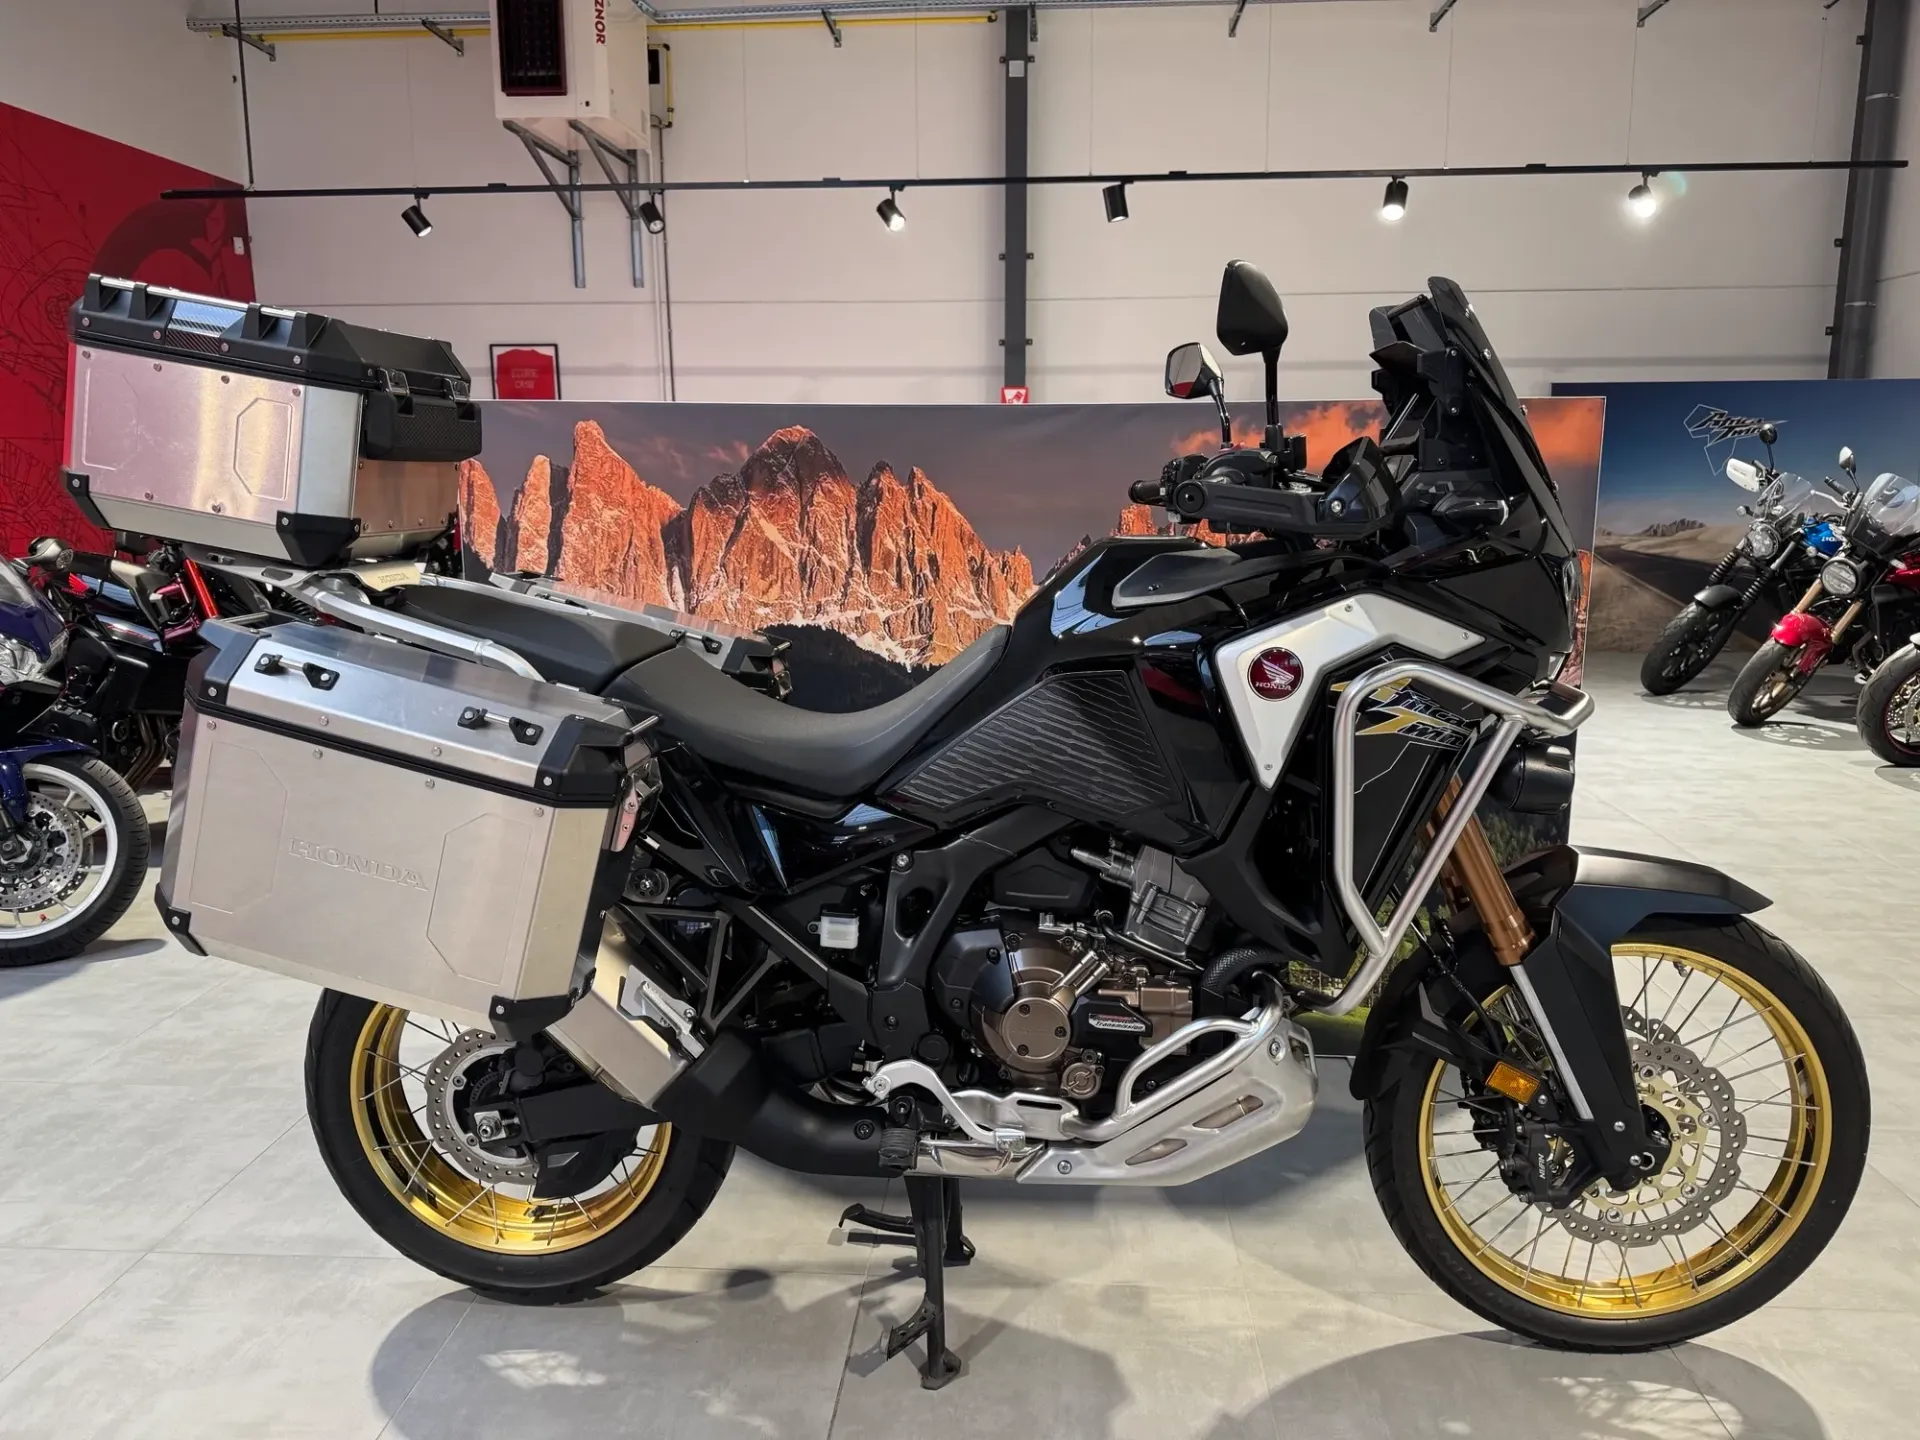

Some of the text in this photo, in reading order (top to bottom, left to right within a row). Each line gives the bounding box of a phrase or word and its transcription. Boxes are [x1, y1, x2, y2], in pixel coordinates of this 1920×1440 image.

[1255, 681, 1292, 691] HONDA
[288, 837, 429, 892] HONDA
[1095, 1021, 1144, 1030] Transmission
